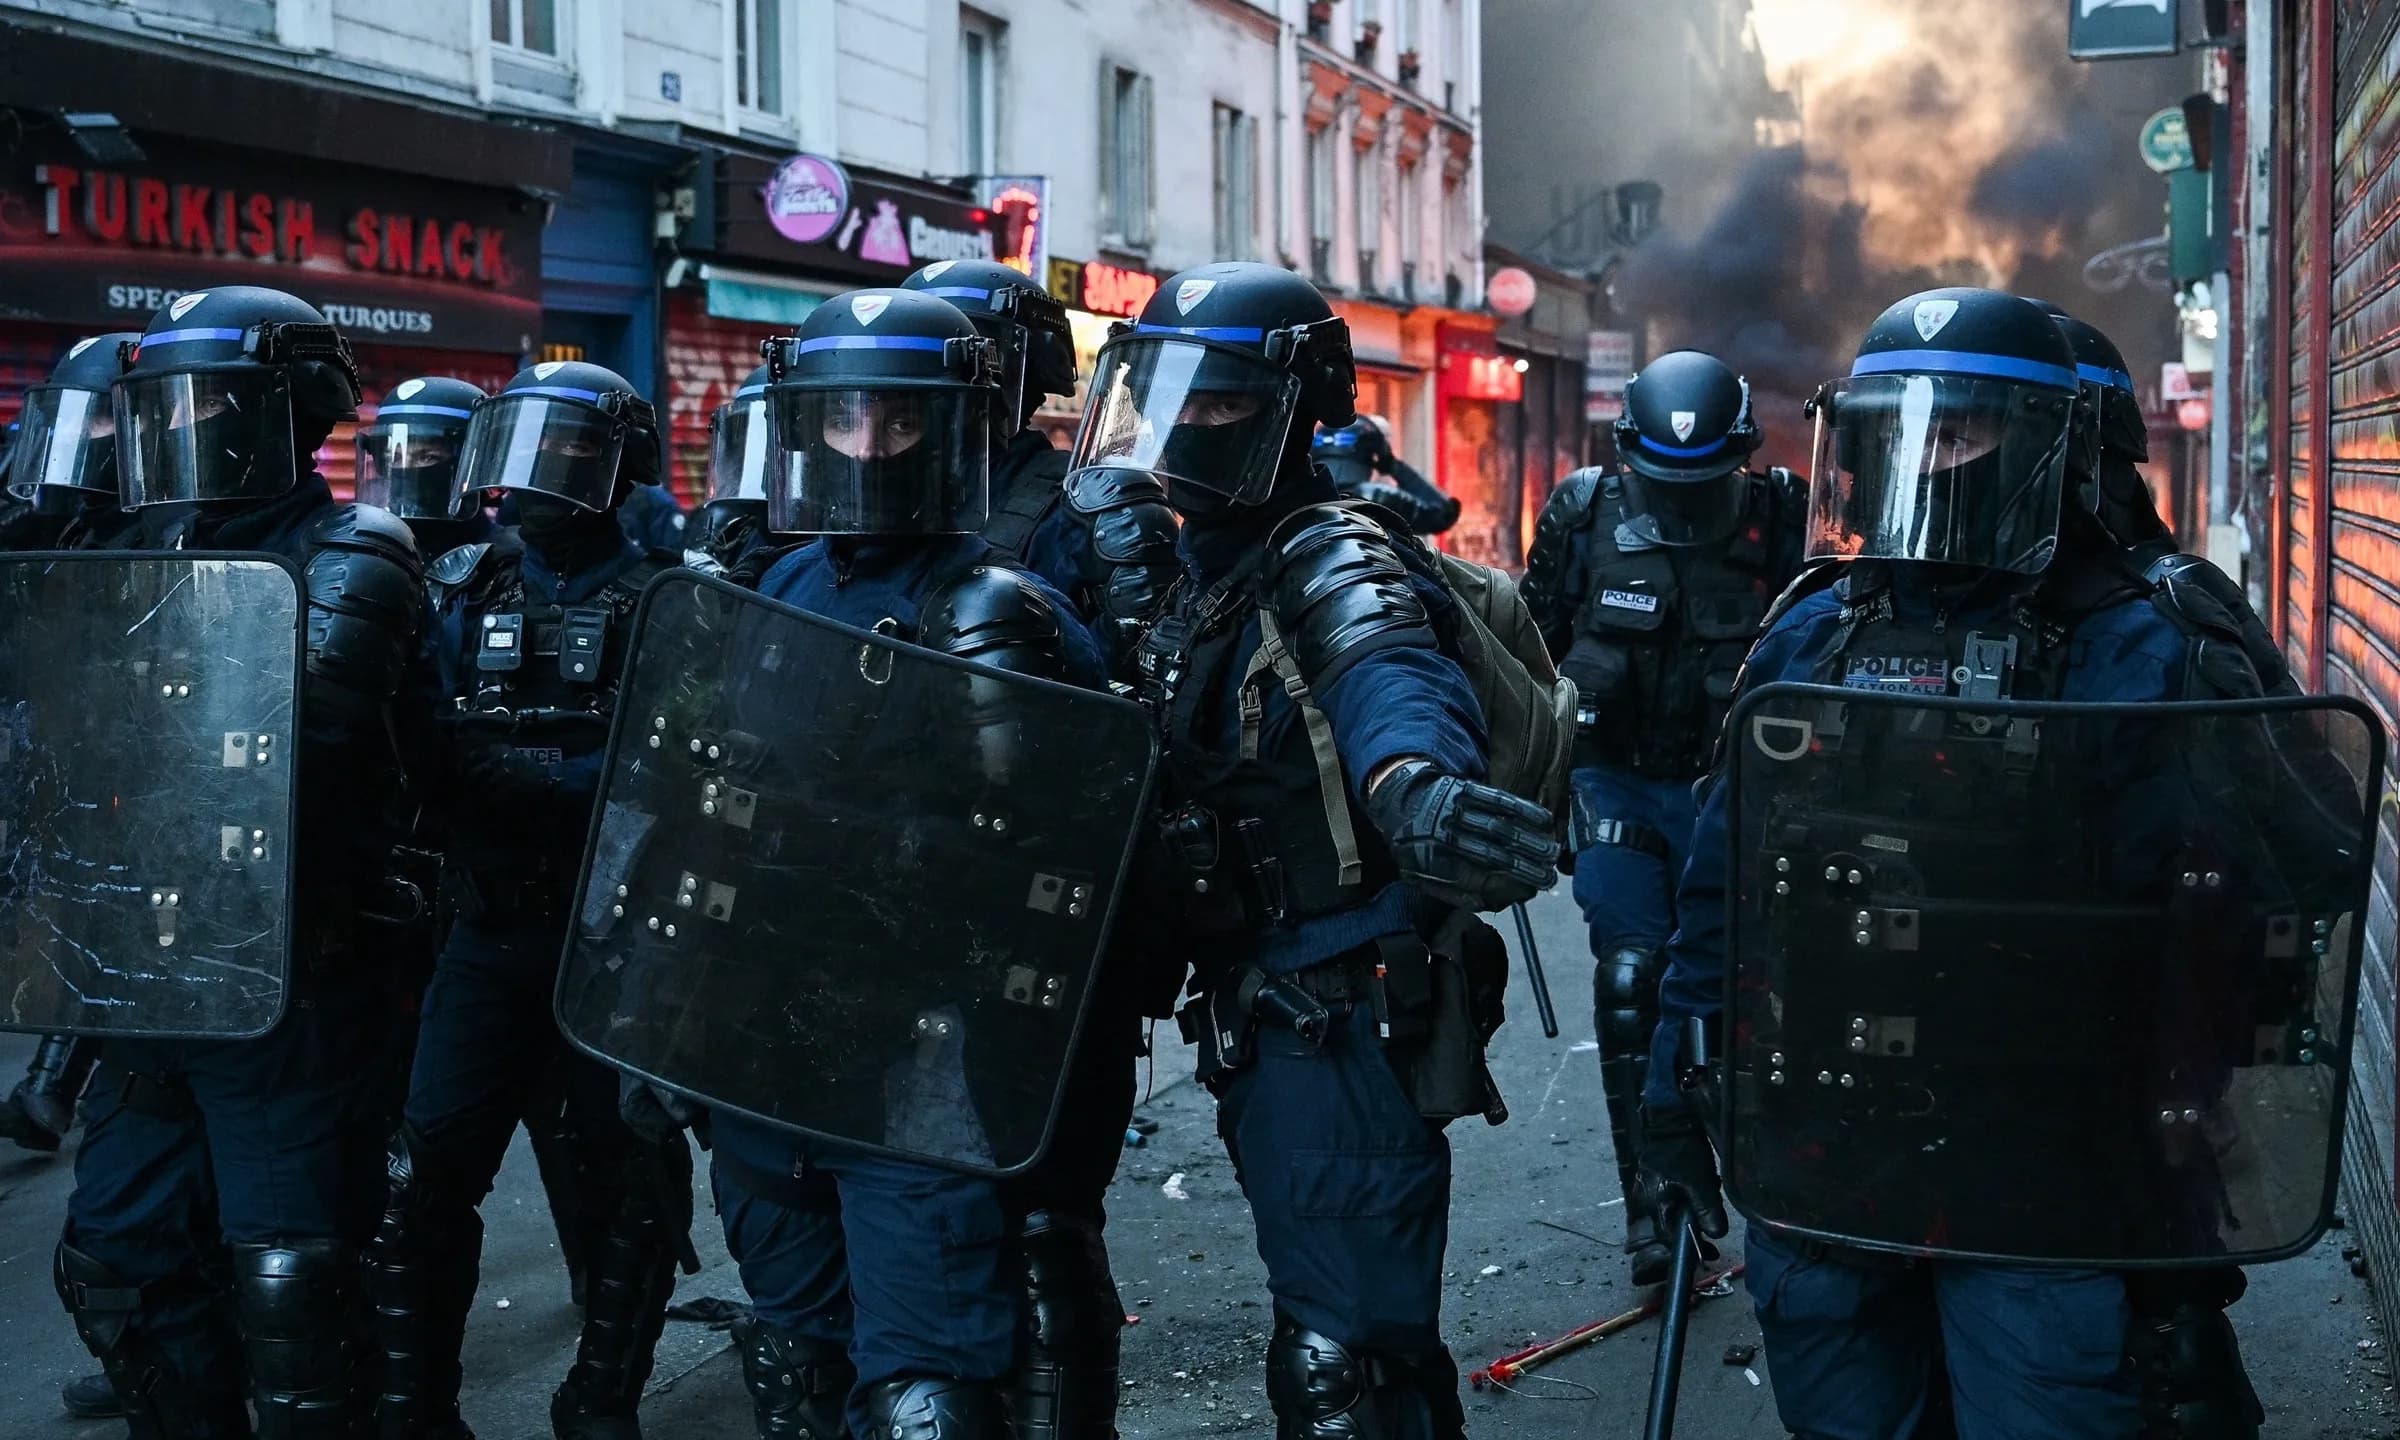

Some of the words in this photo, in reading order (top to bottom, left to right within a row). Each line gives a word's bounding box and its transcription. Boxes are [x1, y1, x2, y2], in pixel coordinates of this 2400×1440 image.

[36, 164, 315, 262] TURKISH
[348, 207, 505, 283] SNACK
[108, 285, 188, 310] SPEC
[322, 304, 433, 332] TURQUES
[1604, 591, 1654, 606] POLICE
[1850, 656, 1944, 677] POLICE
[1845, 681, 1945, 695] NATIONALE
